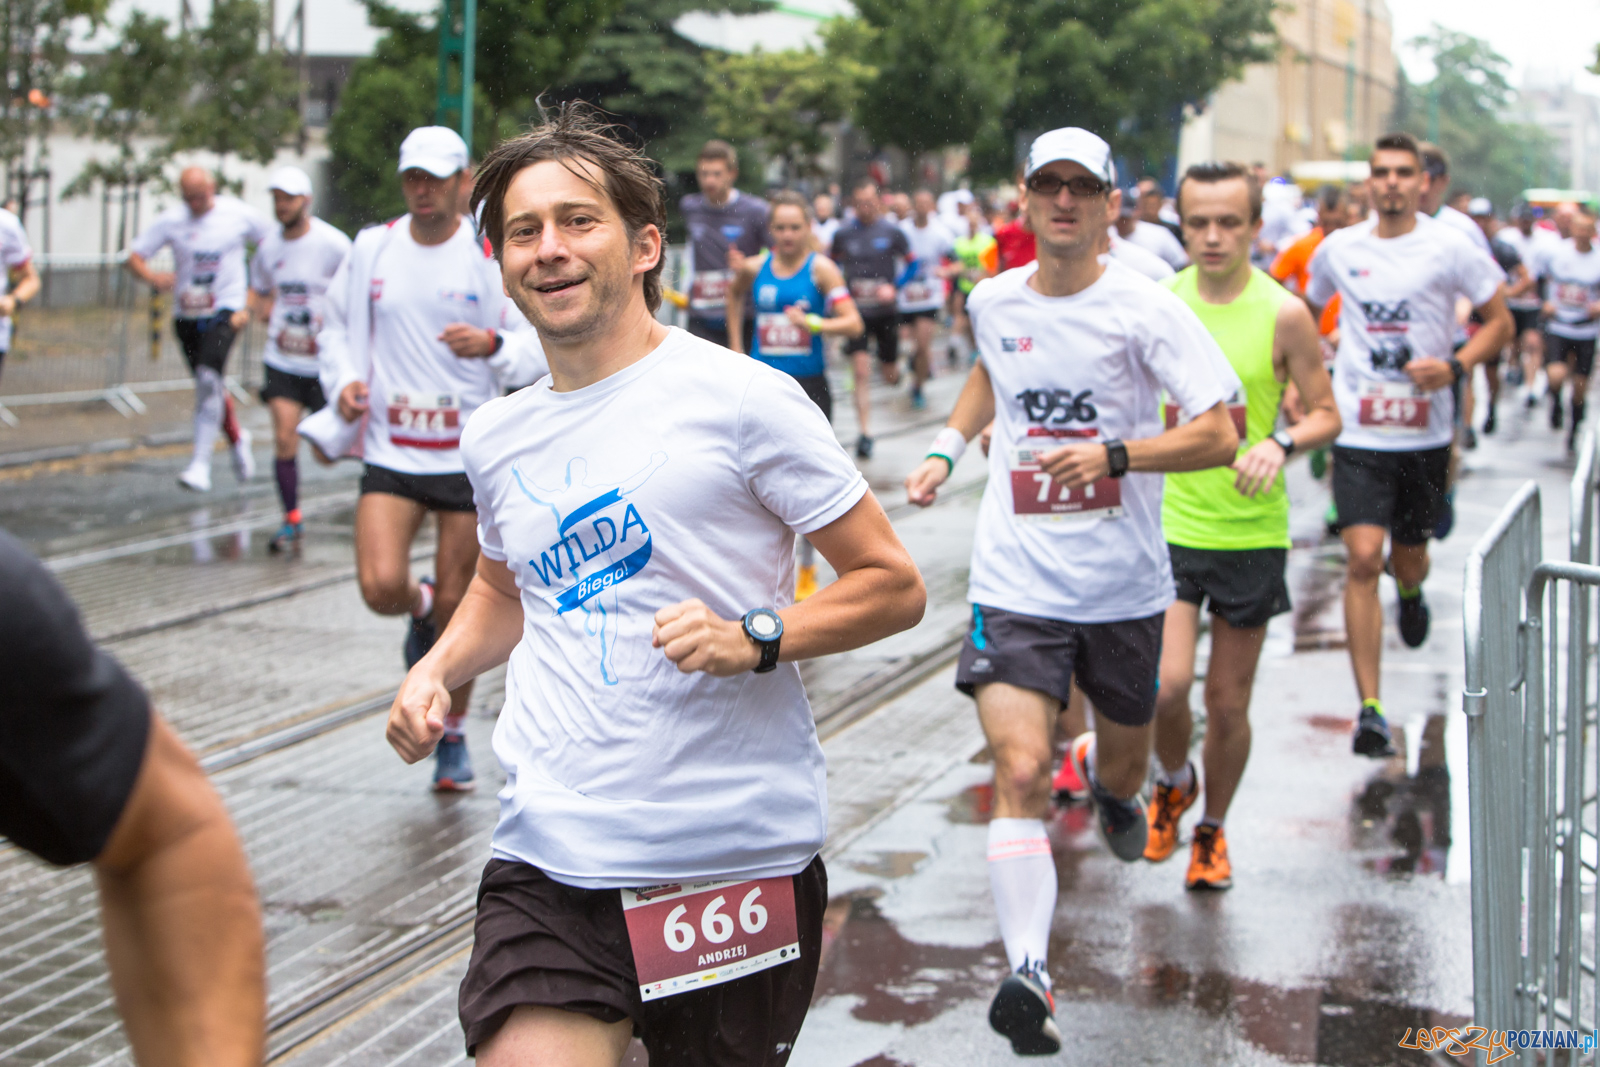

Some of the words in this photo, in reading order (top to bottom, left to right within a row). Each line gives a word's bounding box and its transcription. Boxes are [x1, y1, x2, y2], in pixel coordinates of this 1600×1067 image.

[398, 409, 447, 432] 944
[1016, 388, 1098, 424] 1956
[529, 502, 649, 587] WILDA
[577, 560, 629, 600] Biega!
[663, 886, 768, 953] 666
[697, 944, 748, 967] ANDRZEJ
